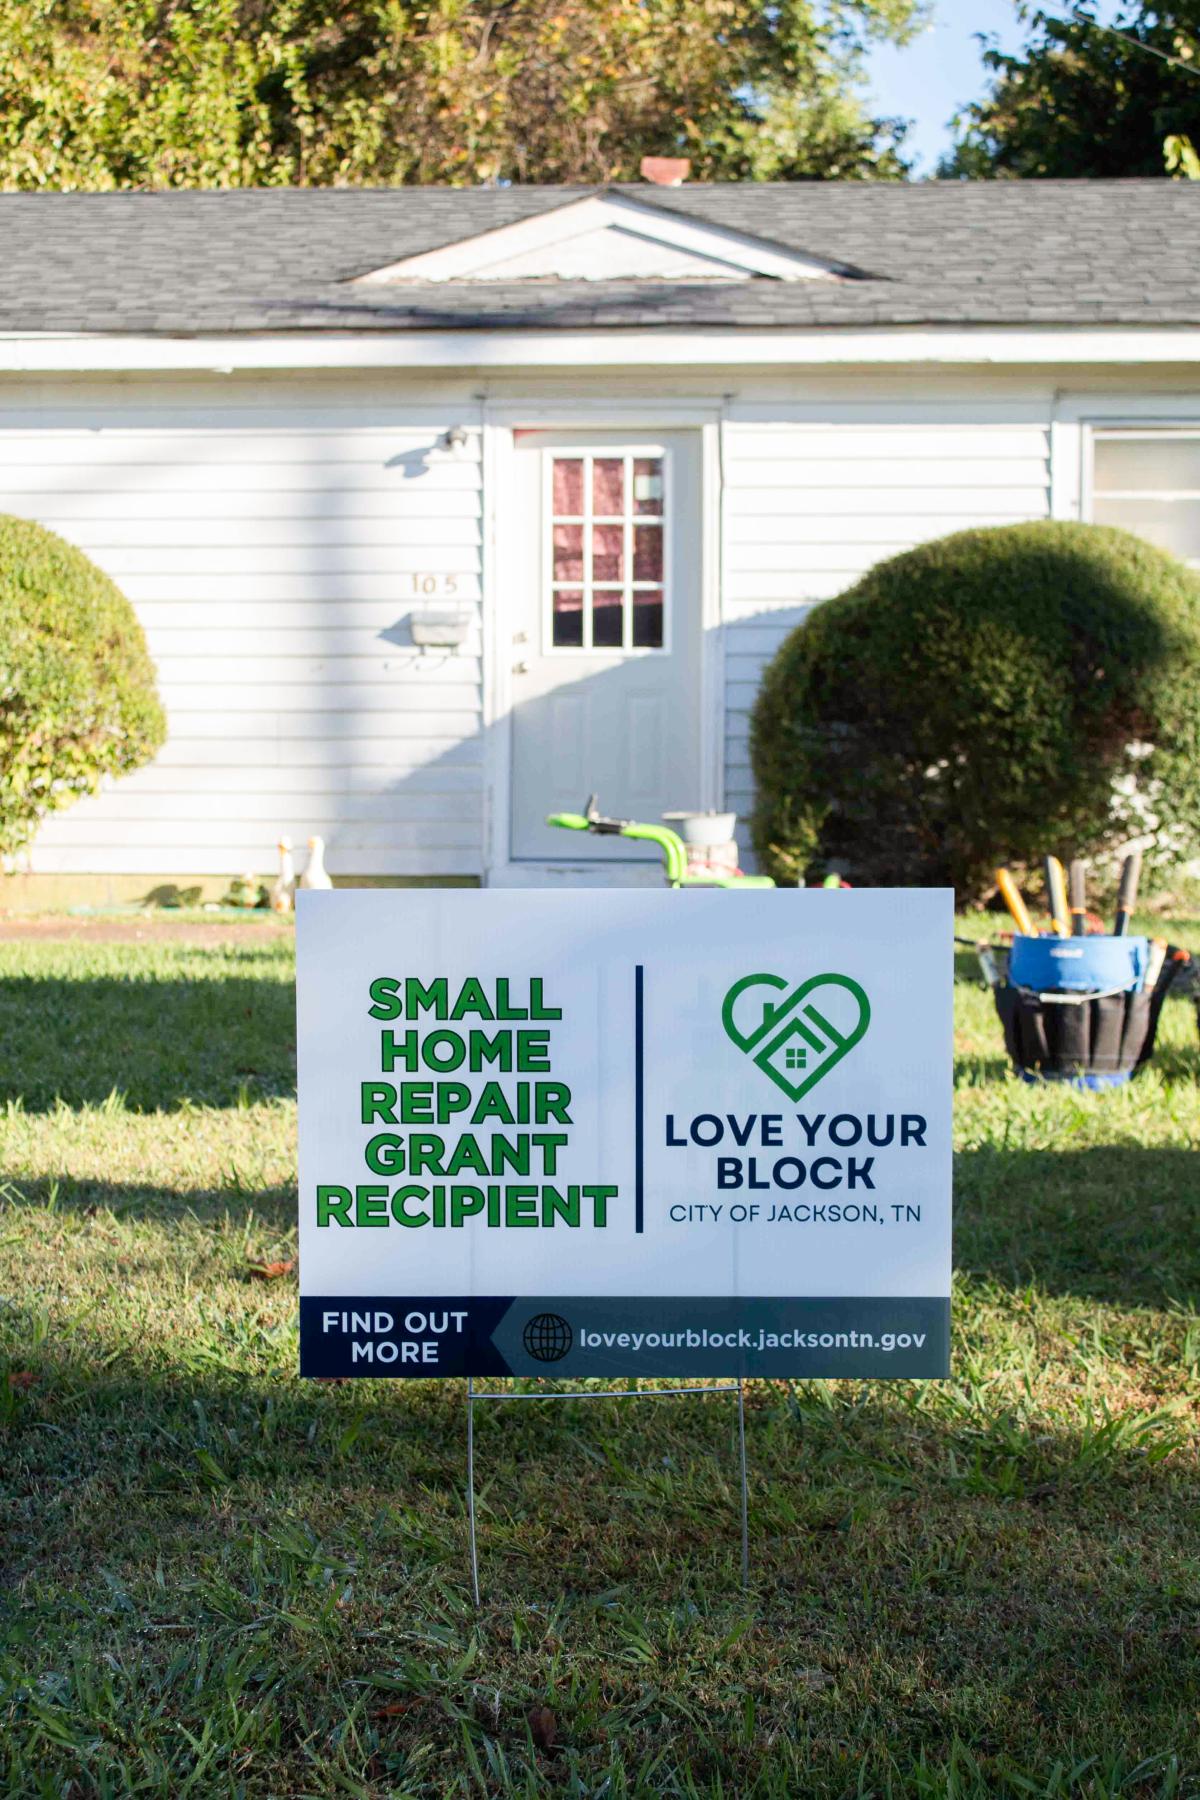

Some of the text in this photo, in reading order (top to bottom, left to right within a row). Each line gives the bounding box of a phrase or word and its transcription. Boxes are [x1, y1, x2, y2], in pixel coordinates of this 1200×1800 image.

[368, 977, 562, 1021] SMALL
[381, 1029, 551, 1073] HOME
[361, 1081, 574, 1125] REPAIR
[666, 1114, 927, 1147] LOVE YOUR
[365, 1133, 568, 1177] GRANT
[717, 1157, 876, 1190] BLOCK
[316, 1185, 619, 1228] RECIPIENT
[669, 1204, 921, 1225] CITY OF JACKSON, TN
[322, 1311, 469, 1334] FIND OUT
[352, 1341, 439, 1363] MORE
[579, 1328, 927, 1352] loveyourblock.jacksontn.gov
